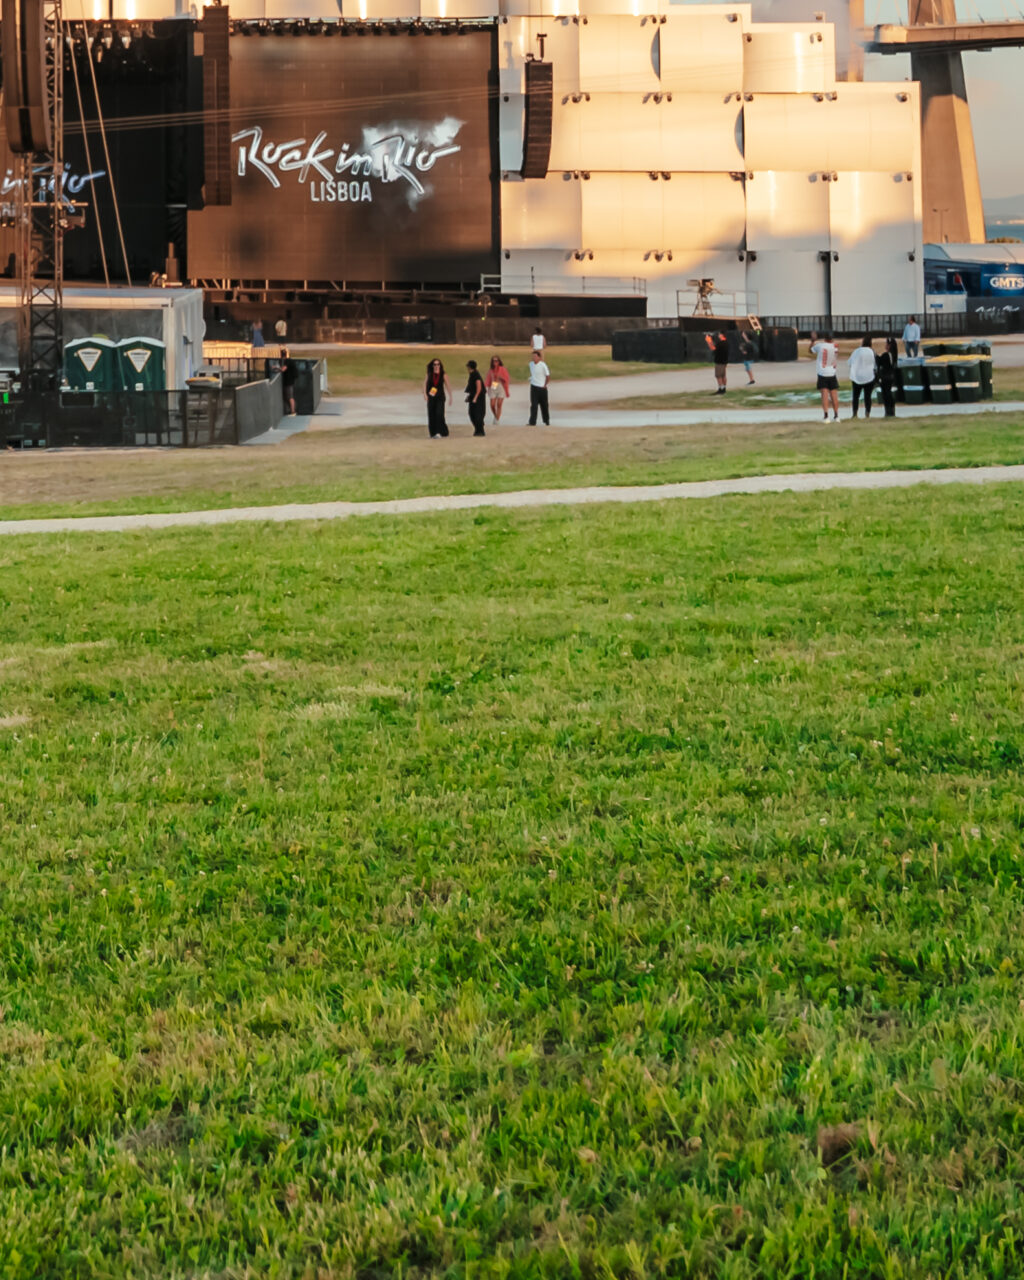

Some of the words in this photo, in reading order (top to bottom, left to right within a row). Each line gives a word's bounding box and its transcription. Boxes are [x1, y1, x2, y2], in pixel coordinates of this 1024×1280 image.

[232, 126, 335, 189] Rock
[335, 143, 373, 176] in
[371, 134, 461, 195] Rio
[311, 180, 373, 202] LISBOA
[989, 276, 1024, 289] GMTS
